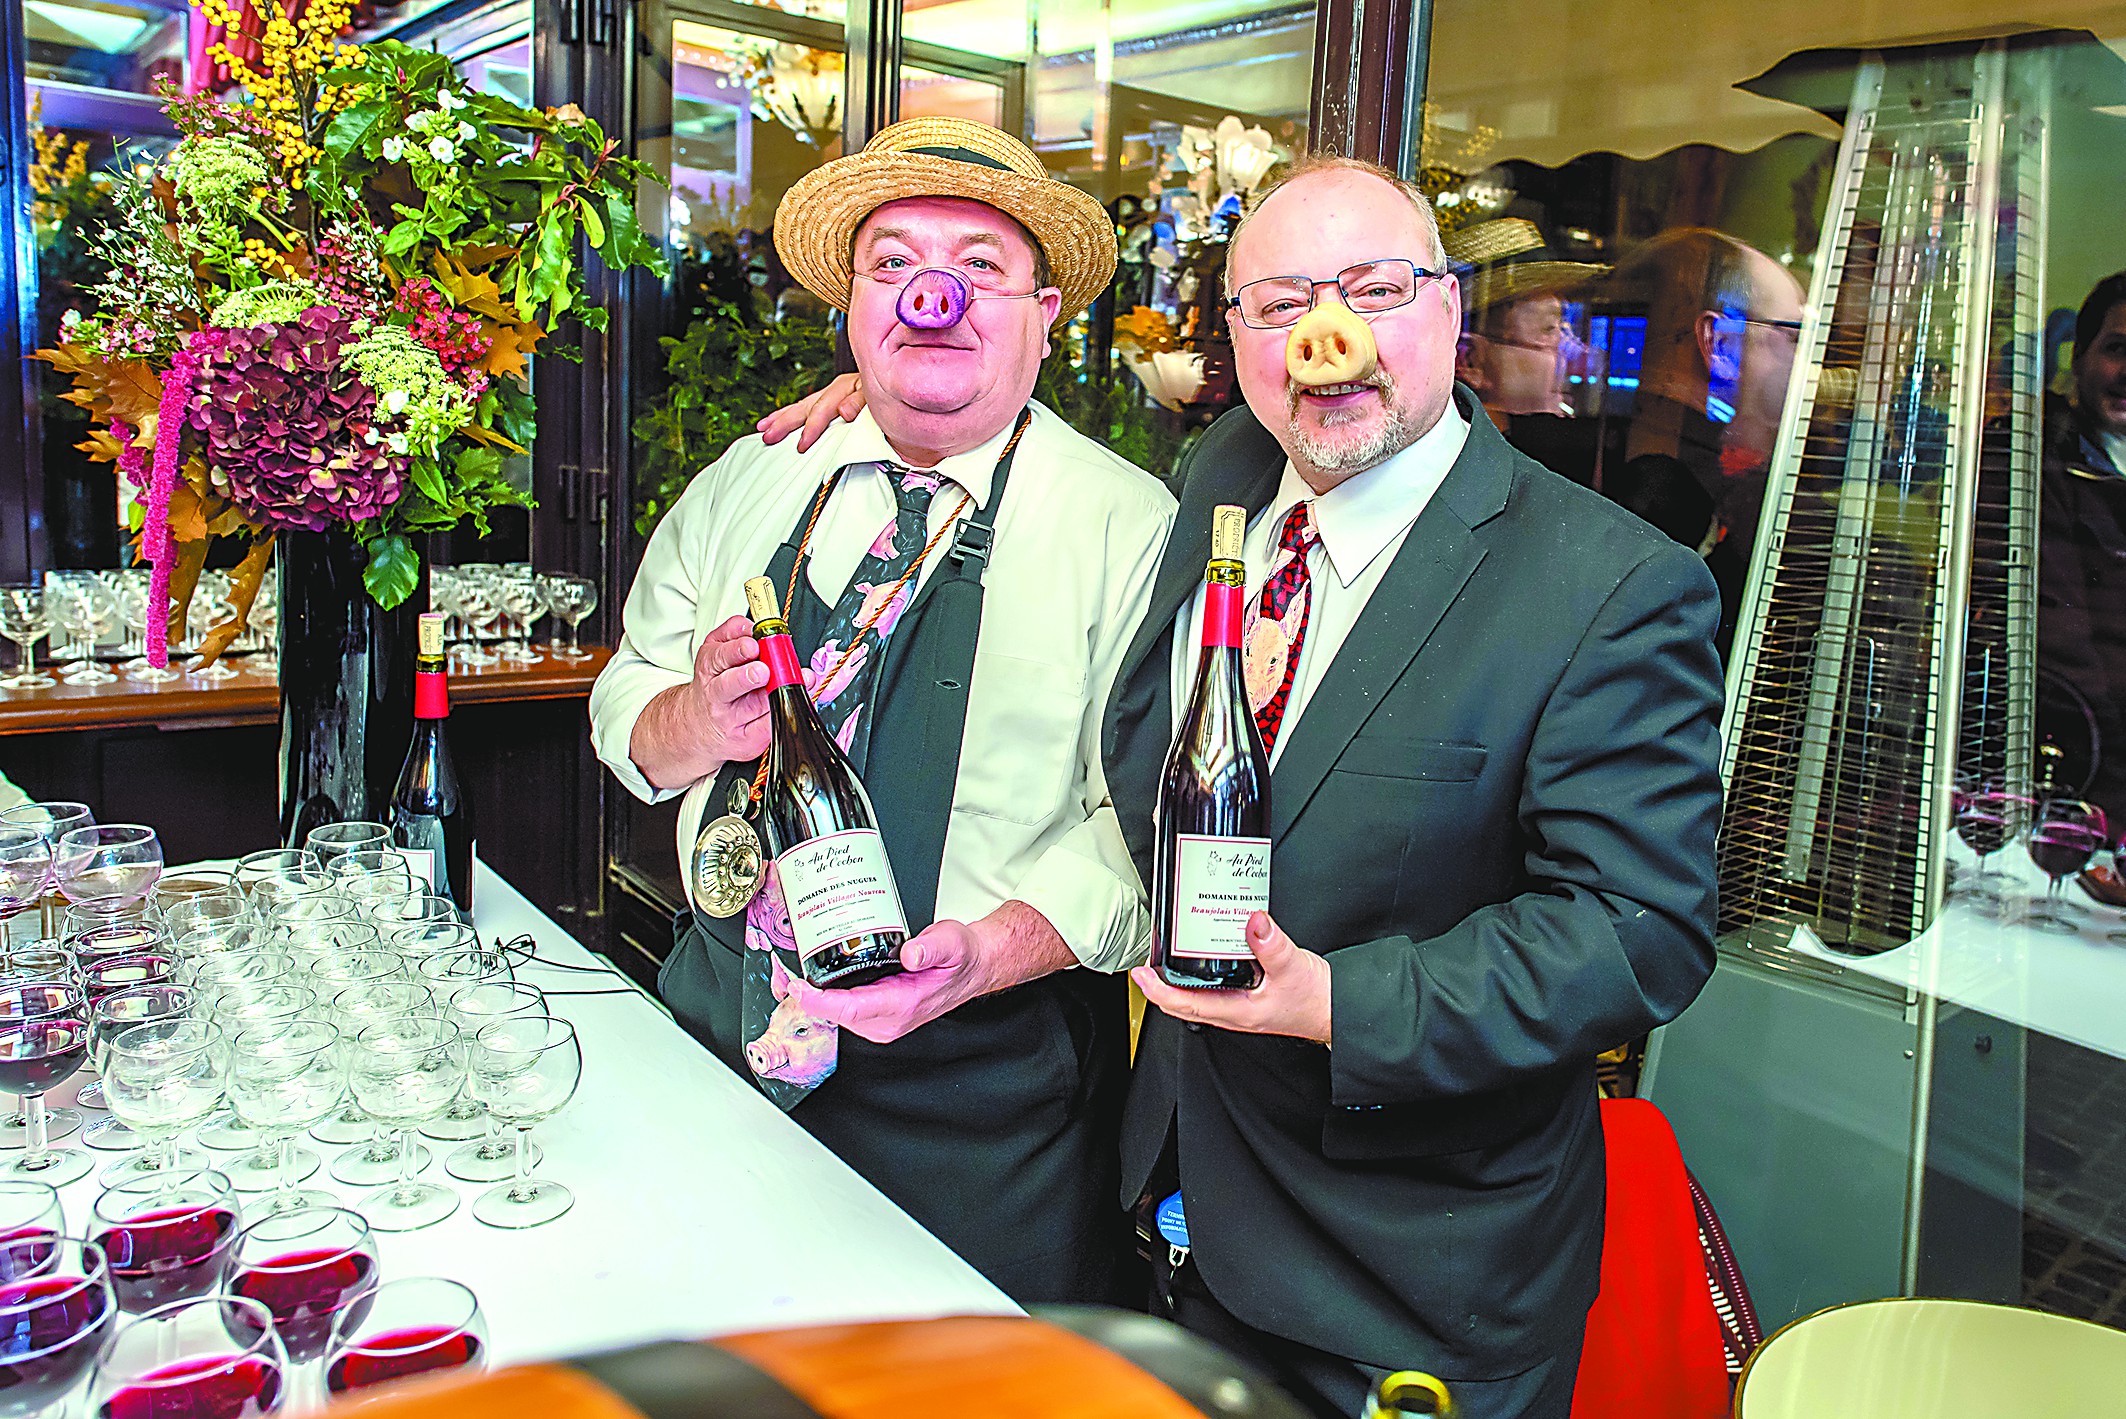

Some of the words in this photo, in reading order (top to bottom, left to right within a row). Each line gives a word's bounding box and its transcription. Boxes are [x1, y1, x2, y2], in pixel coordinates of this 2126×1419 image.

[808, 852, 823, 865] Au
[824, 844, 850, 860] Pied
[1227, 853, 1243, 867] Au
[1244, 853, 1264, 867] Pied
[797, 887, 829, 906] DOMAINE
[830, 882, 846, 891] DES
[1198, 893, 1238, 901] DOMAINE
[1190, 906, 1231, 916] Beaujolais
